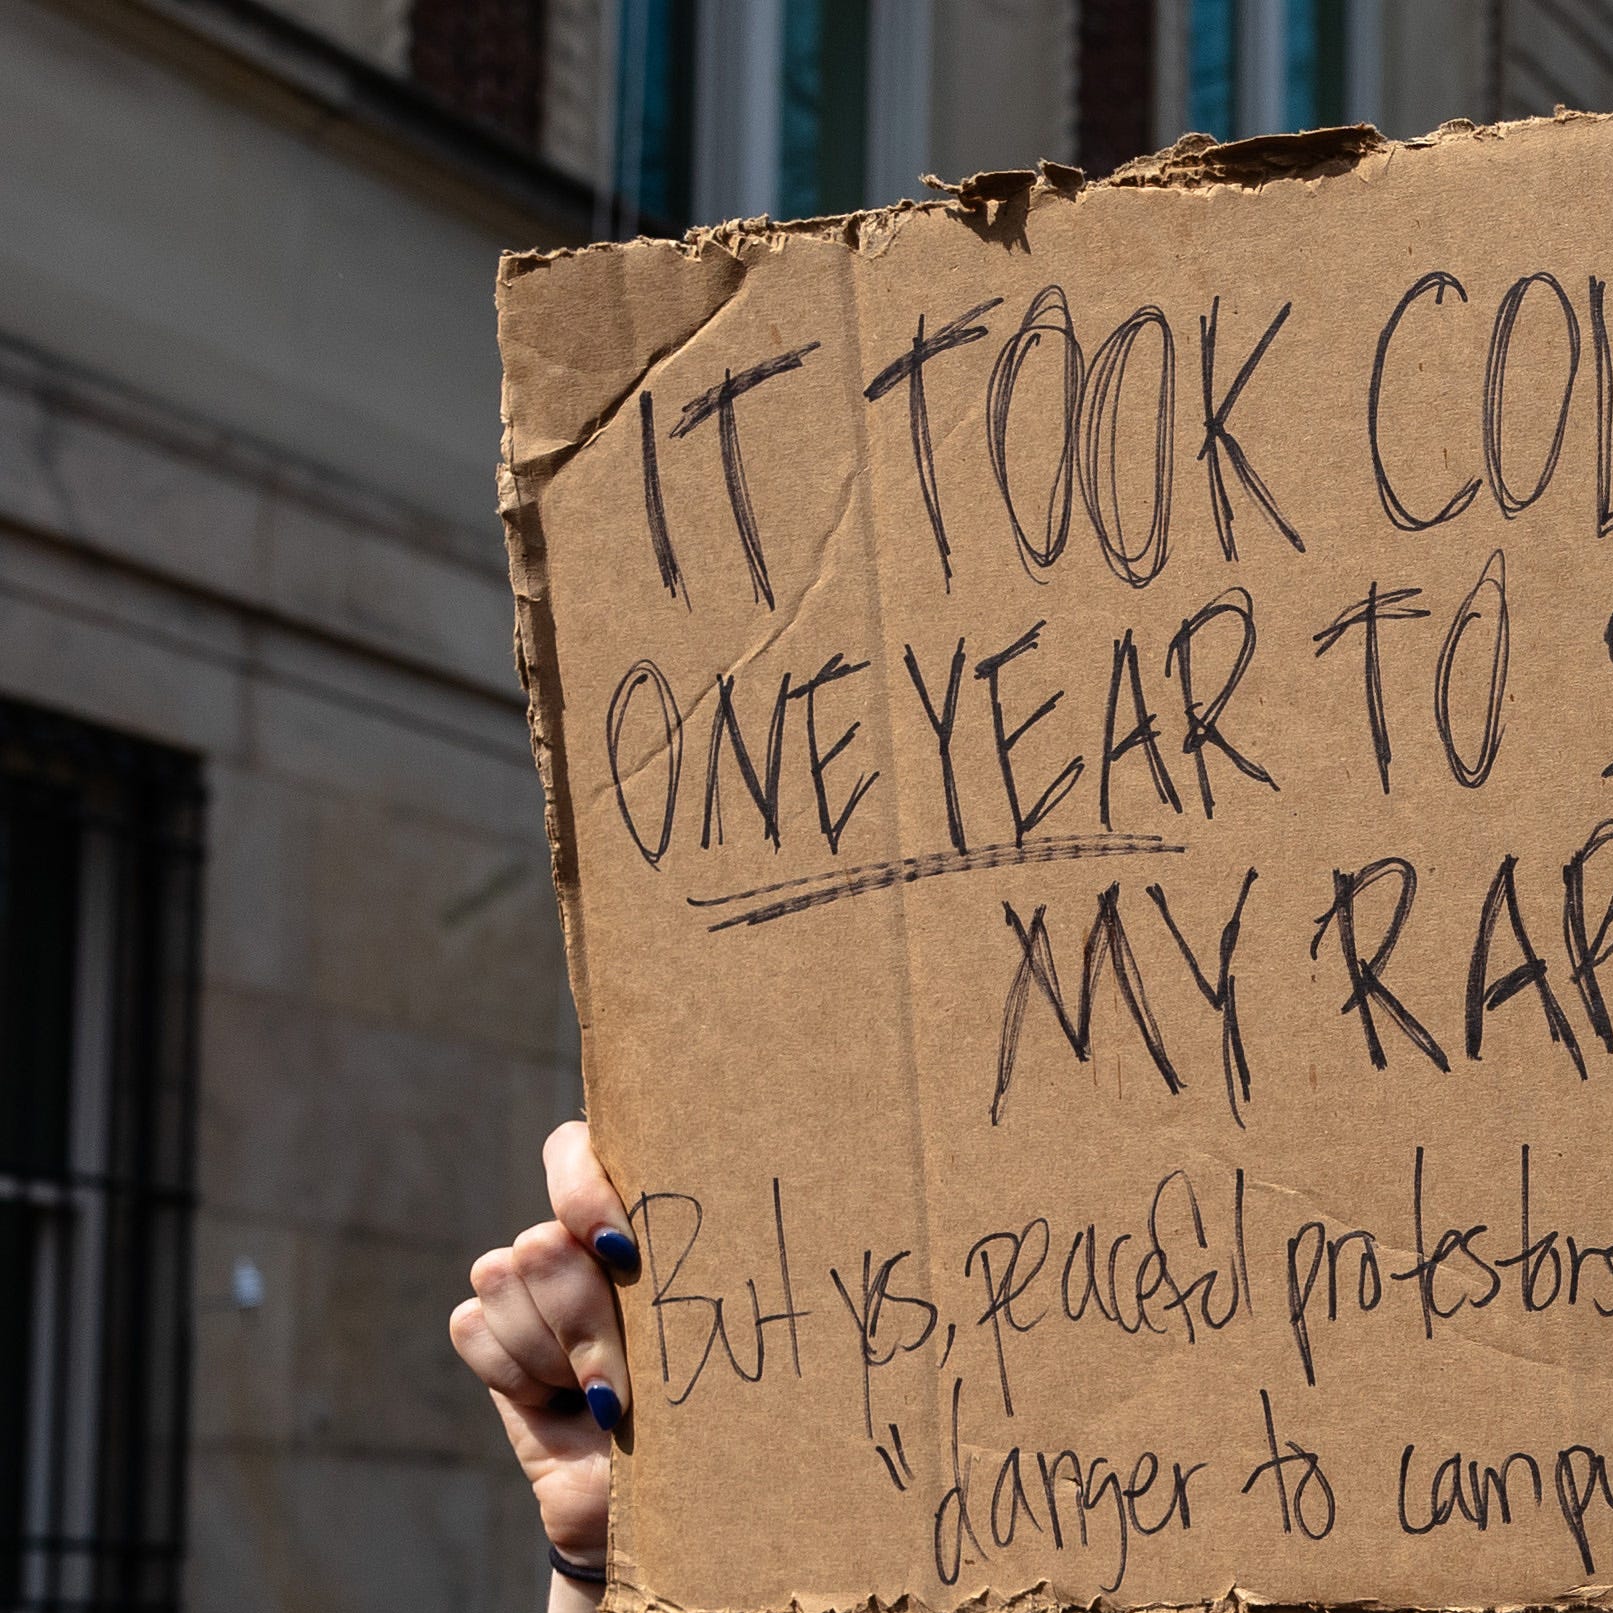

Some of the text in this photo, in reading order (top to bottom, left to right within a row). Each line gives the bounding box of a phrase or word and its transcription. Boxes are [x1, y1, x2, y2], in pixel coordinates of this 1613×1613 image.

[639, 339, 822, 612] IT
[864, 284, 1305, 593] TOOK
[606, 651, 881, 870] ONE
[903, 585, 1280, 855] YEAR
[1312, 548, 1510, 794] TO
[990, 866, 1260, 1129] MY
[631, 1176, 812, 1405] But
[964, 1168, 1254, 1418] peaceful
[875, 1377, 1208, 1594] "danger
[1241, 1387, 1336, 1541] to
